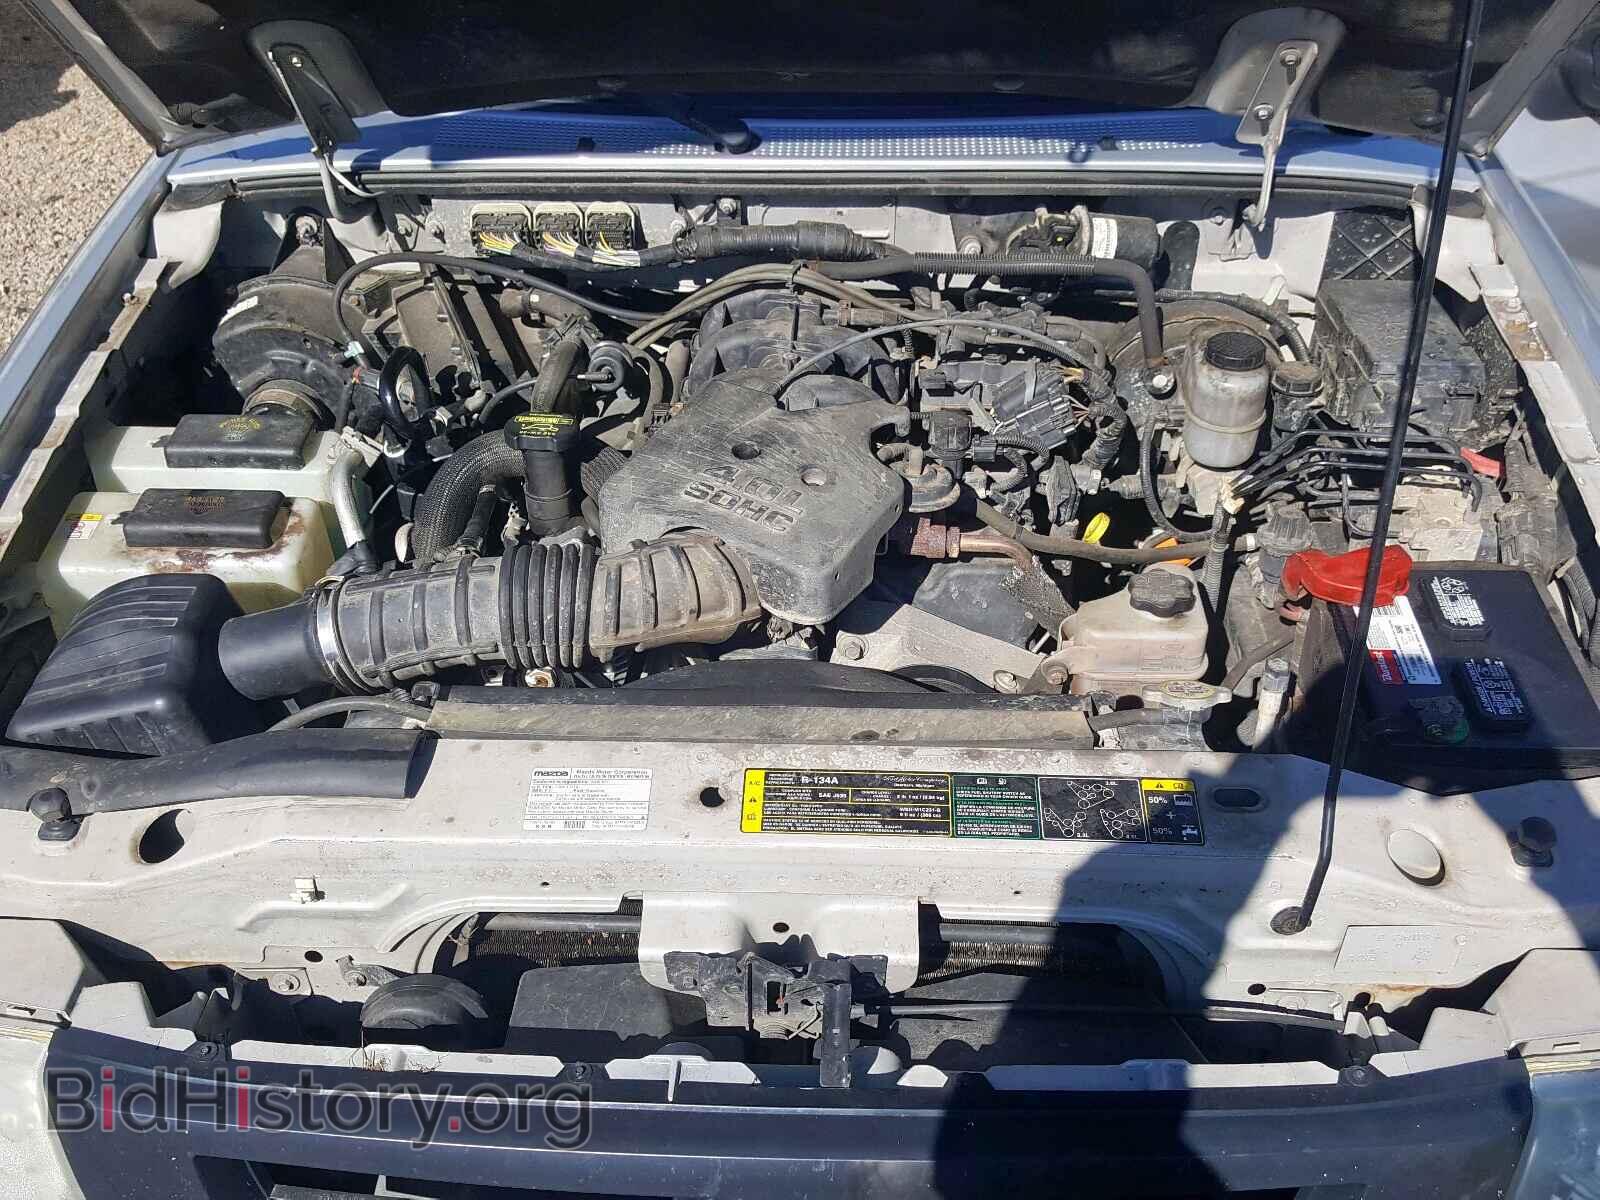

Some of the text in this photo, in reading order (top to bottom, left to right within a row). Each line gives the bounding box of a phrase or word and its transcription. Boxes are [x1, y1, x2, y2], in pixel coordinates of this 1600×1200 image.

[683, 480, 796, 533] SOHC
[1372, 650, 1394, 683] Duralast
[801, 775, 839, 785] R-134A
[1148, 796, 1168, 804] 50%
[1152, 827, 1172, 835] 50%
